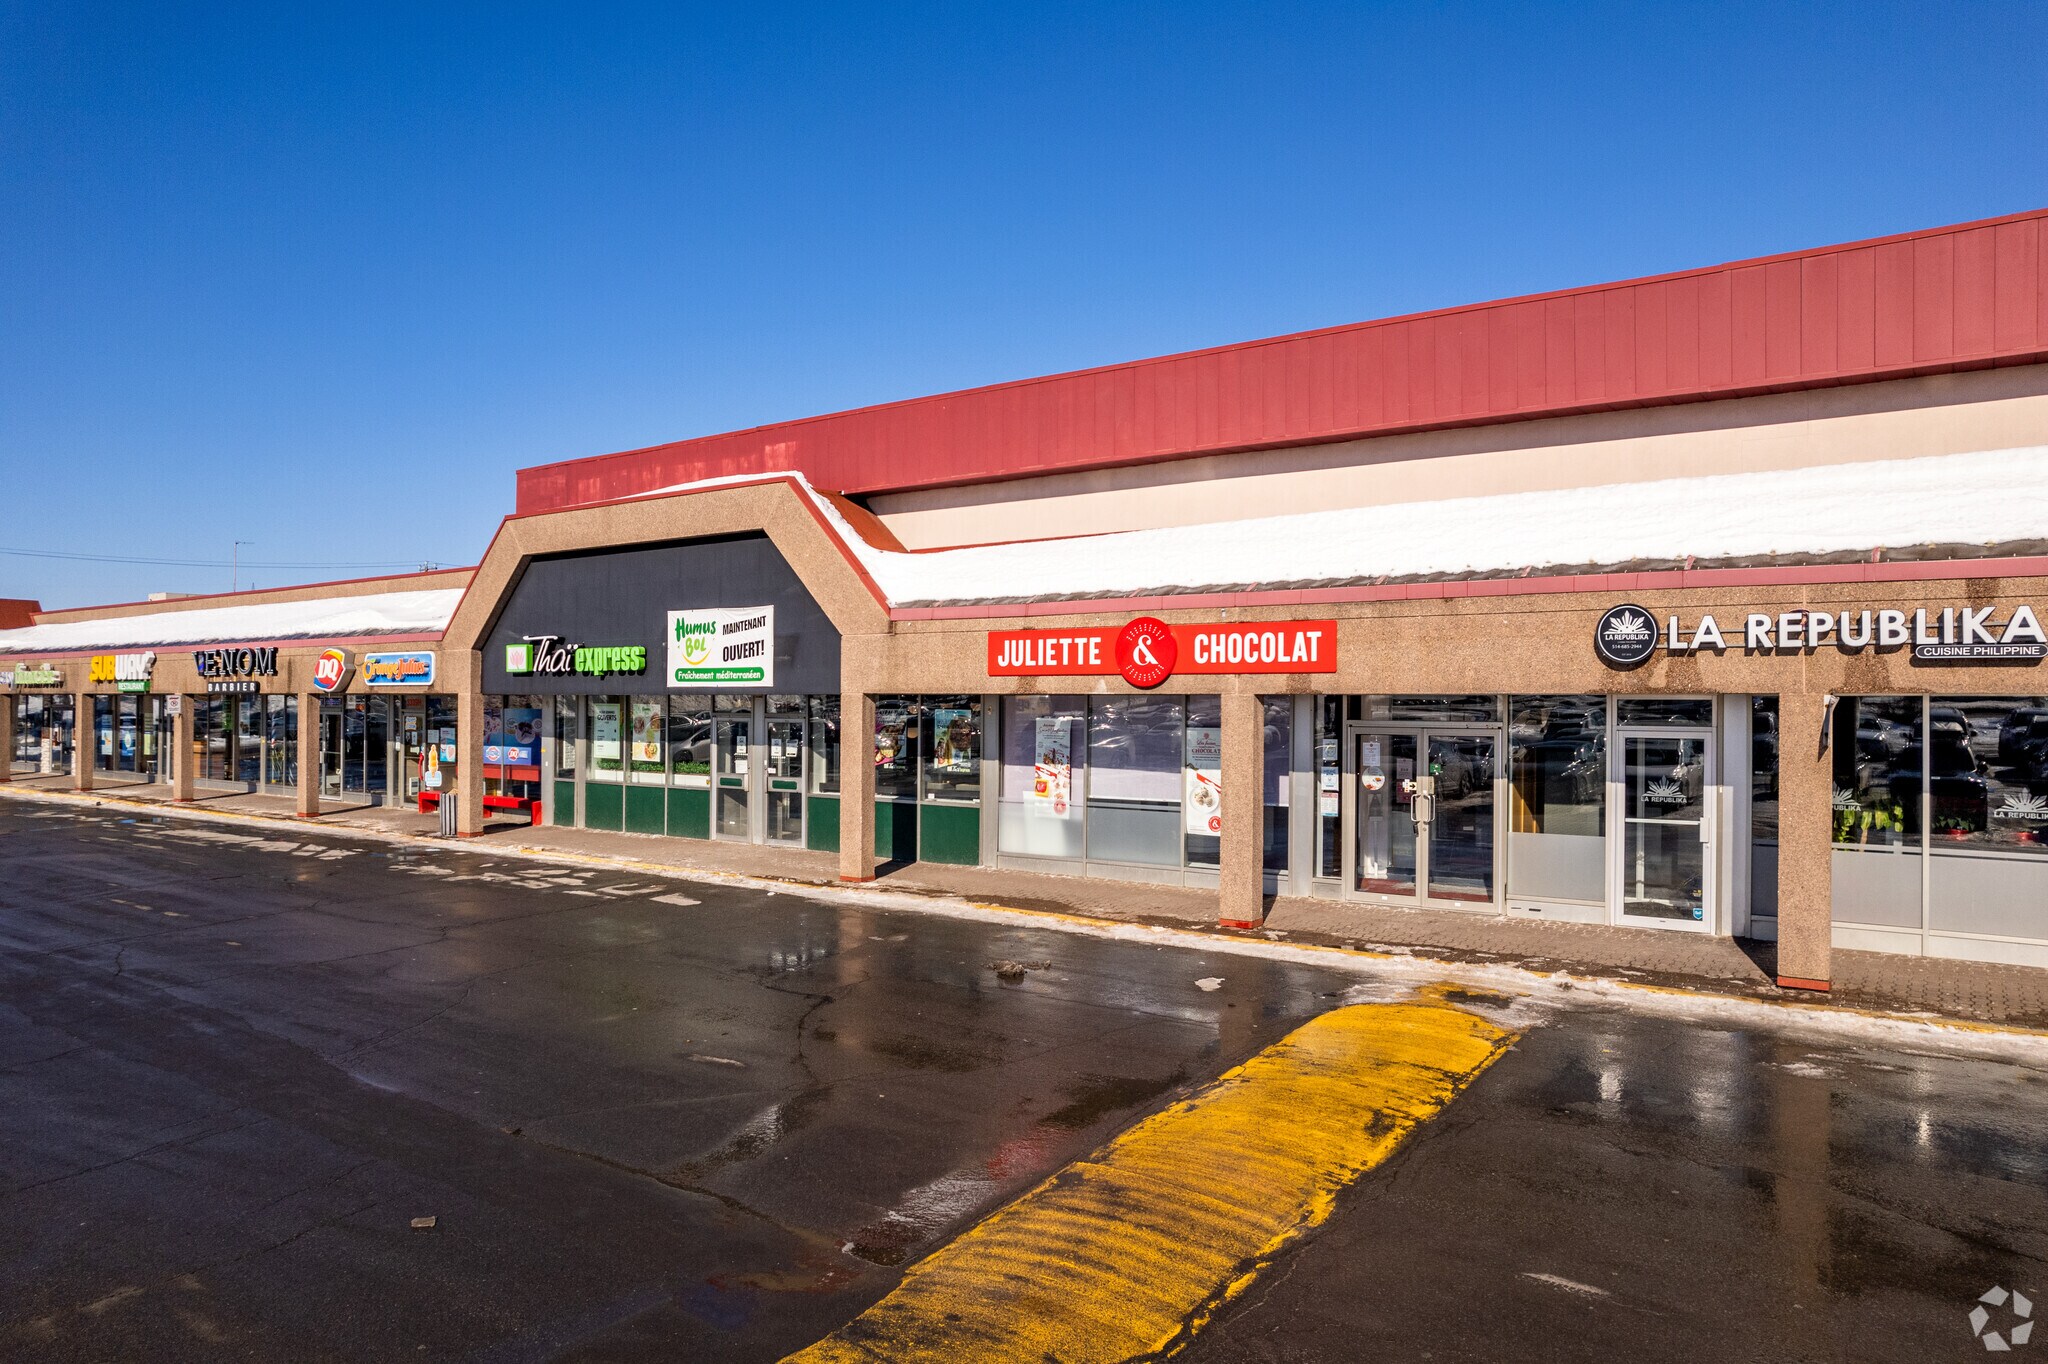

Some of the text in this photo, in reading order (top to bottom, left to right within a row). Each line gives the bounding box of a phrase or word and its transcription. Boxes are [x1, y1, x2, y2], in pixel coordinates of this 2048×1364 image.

[675, 617, 717, 642] Humus
[722, 615, 767, 636] MAINTENANT
[1669, 605, 2048, 650] LA REPUBLIKA
[191, 646, 275, 676] VENOM
[523, 635, 645, 676] Thaï express
[722, 639, 765, 662] OUVERT!
[997, 631, 1323, 667] JULIETTE & CHOCOLAT
[1923, 646, 2041, 656] CUISINE PHILIPPINE
[89, 651, 154, 682] SUBWAY
[317, 658, 340, 682] DQ
[677, 669, 761, 679] Fraîchement méditerranéen
[207, 682, 256, 692] BARBIER
